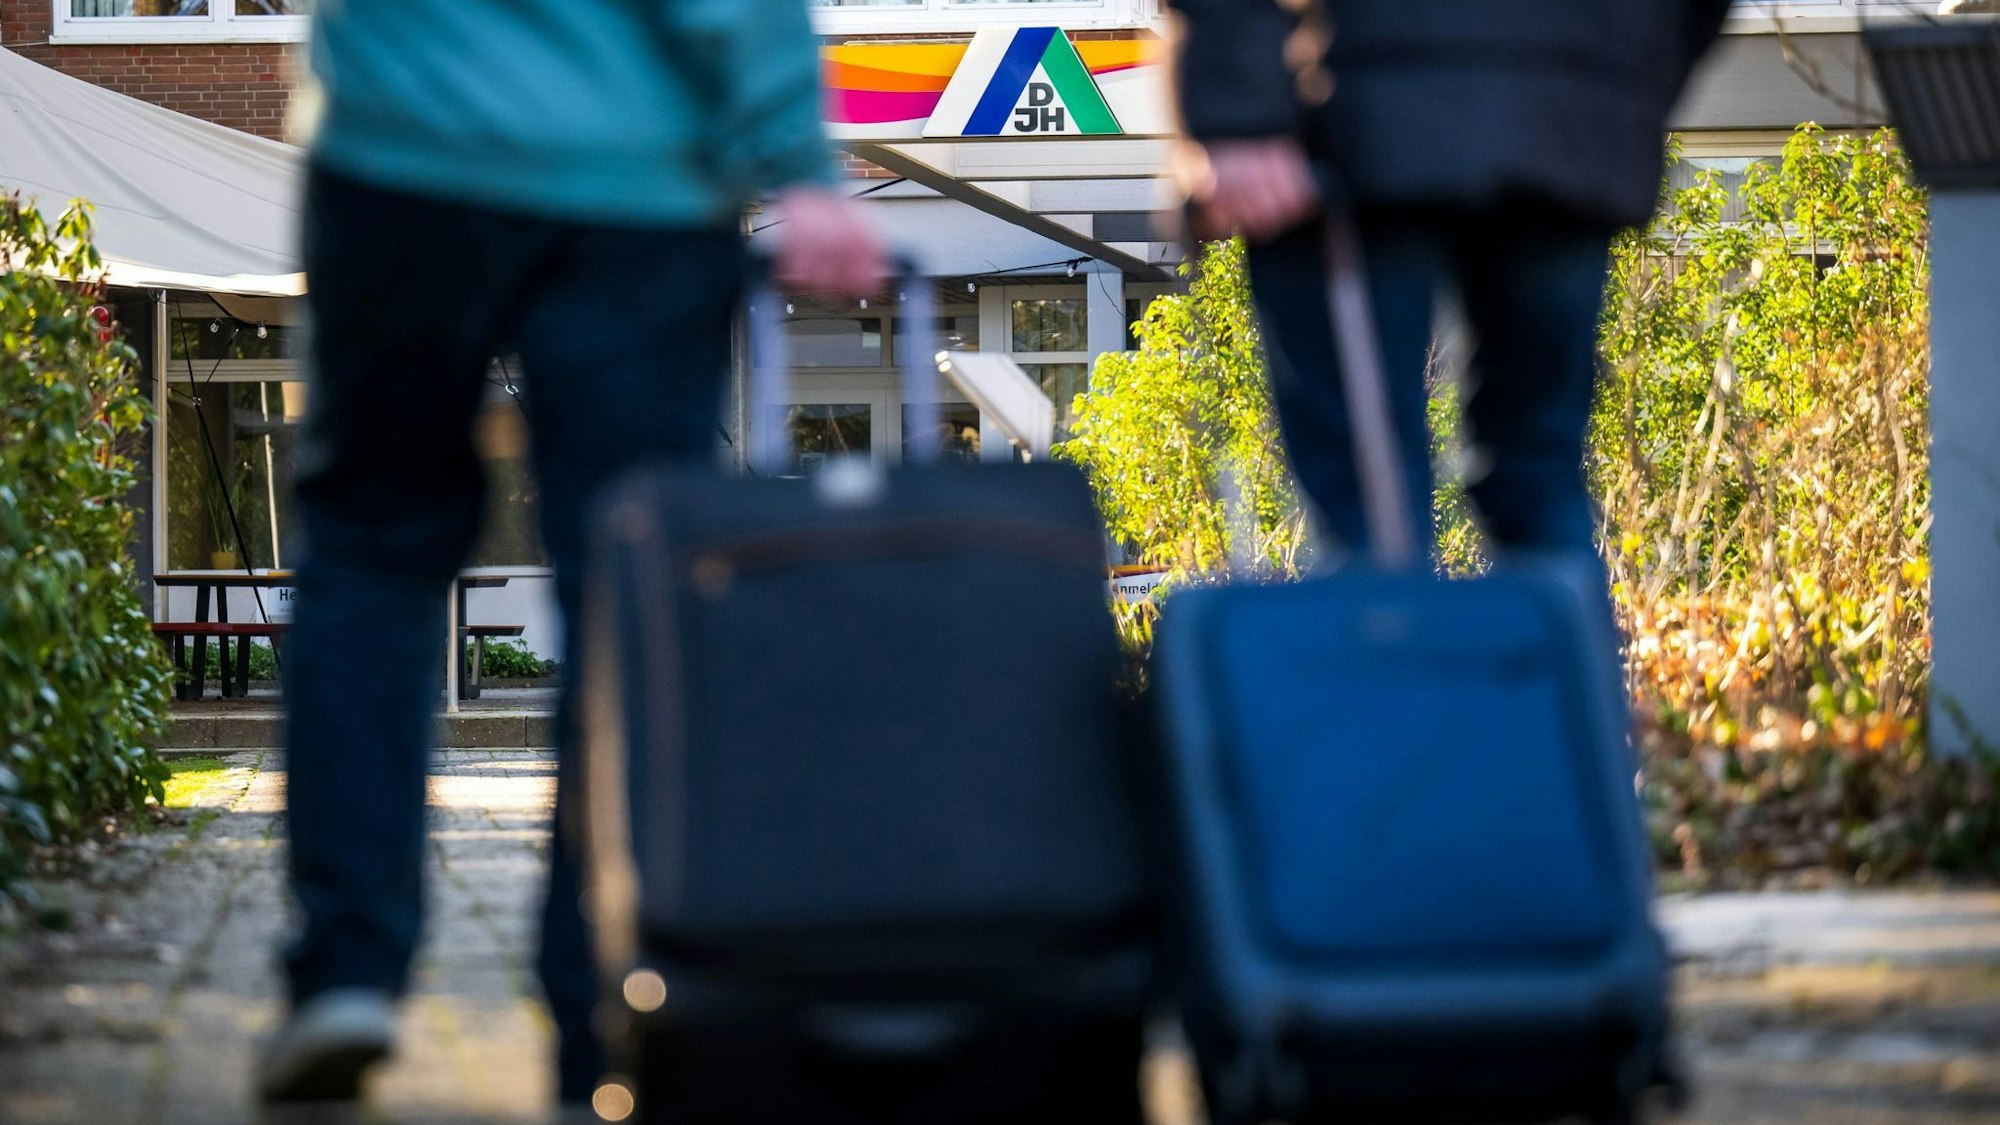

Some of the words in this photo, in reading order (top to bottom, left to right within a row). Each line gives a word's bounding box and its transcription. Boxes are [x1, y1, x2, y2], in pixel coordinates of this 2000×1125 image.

[1029, 82, 1054, 107] D
[1014, 107, 1064, 132] JH
[279, 588, 297, 601] He
